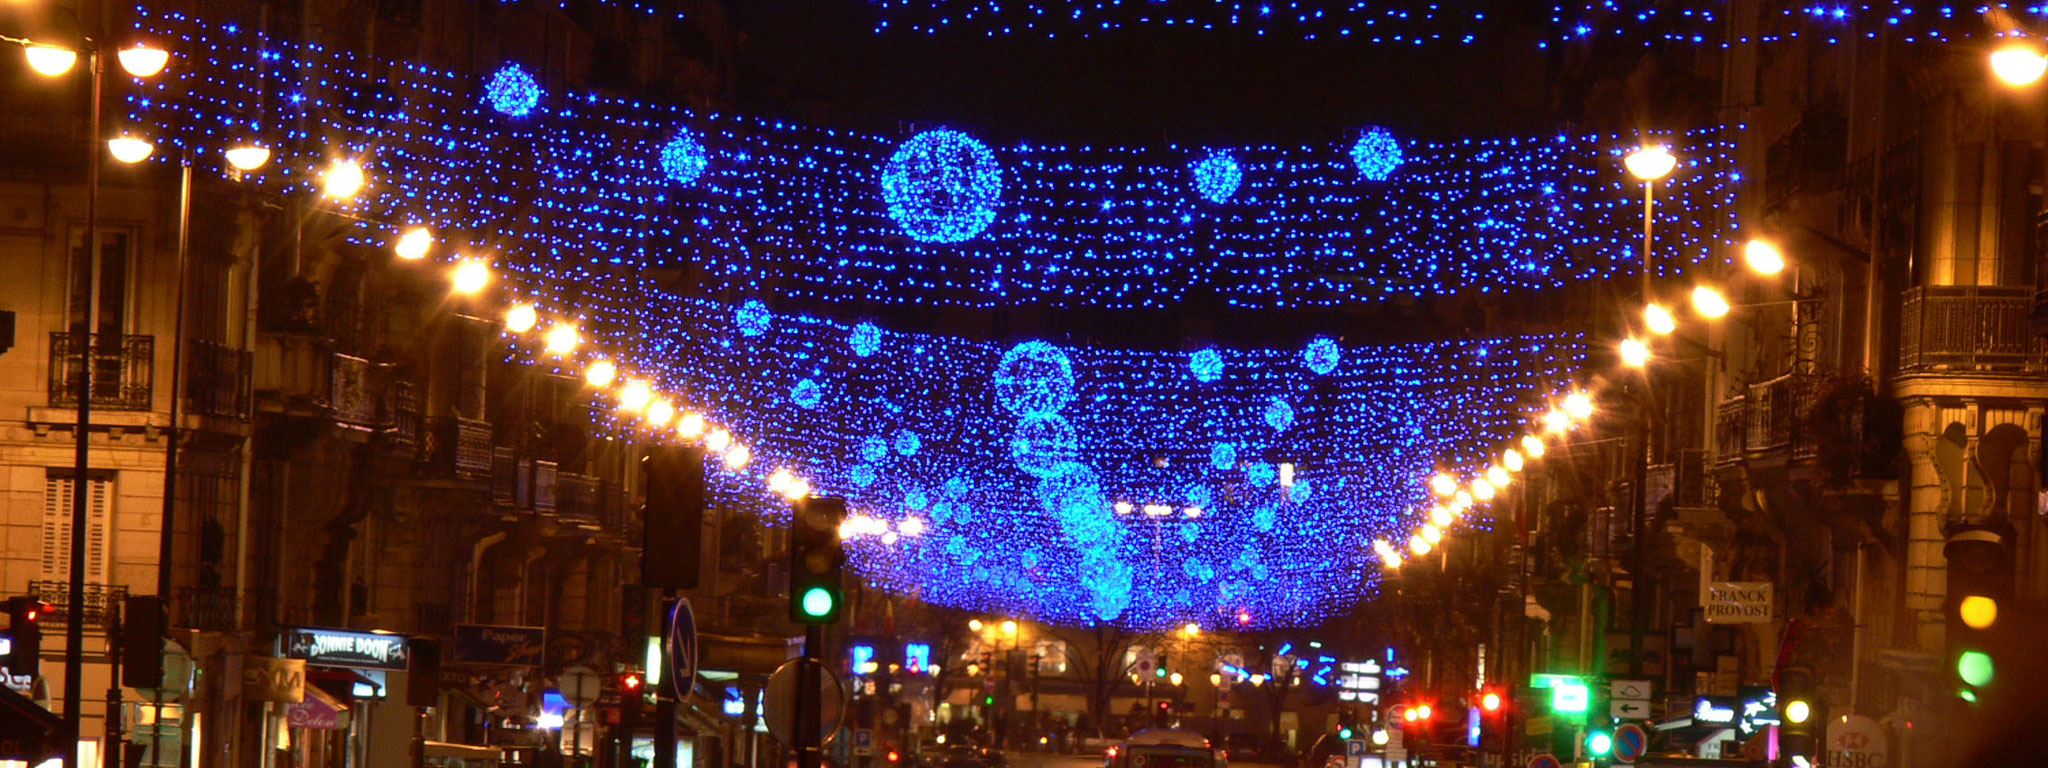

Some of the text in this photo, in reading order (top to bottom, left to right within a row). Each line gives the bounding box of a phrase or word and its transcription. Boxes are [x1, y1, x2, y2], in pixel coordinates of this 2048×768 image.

[1711, 590, 1767, 602] FRANCK
[1708, 604, 1769, 616] PROVOST
[355, 638, 391, 663] DOON
[1827, 750, 1885, 768] HSBC
